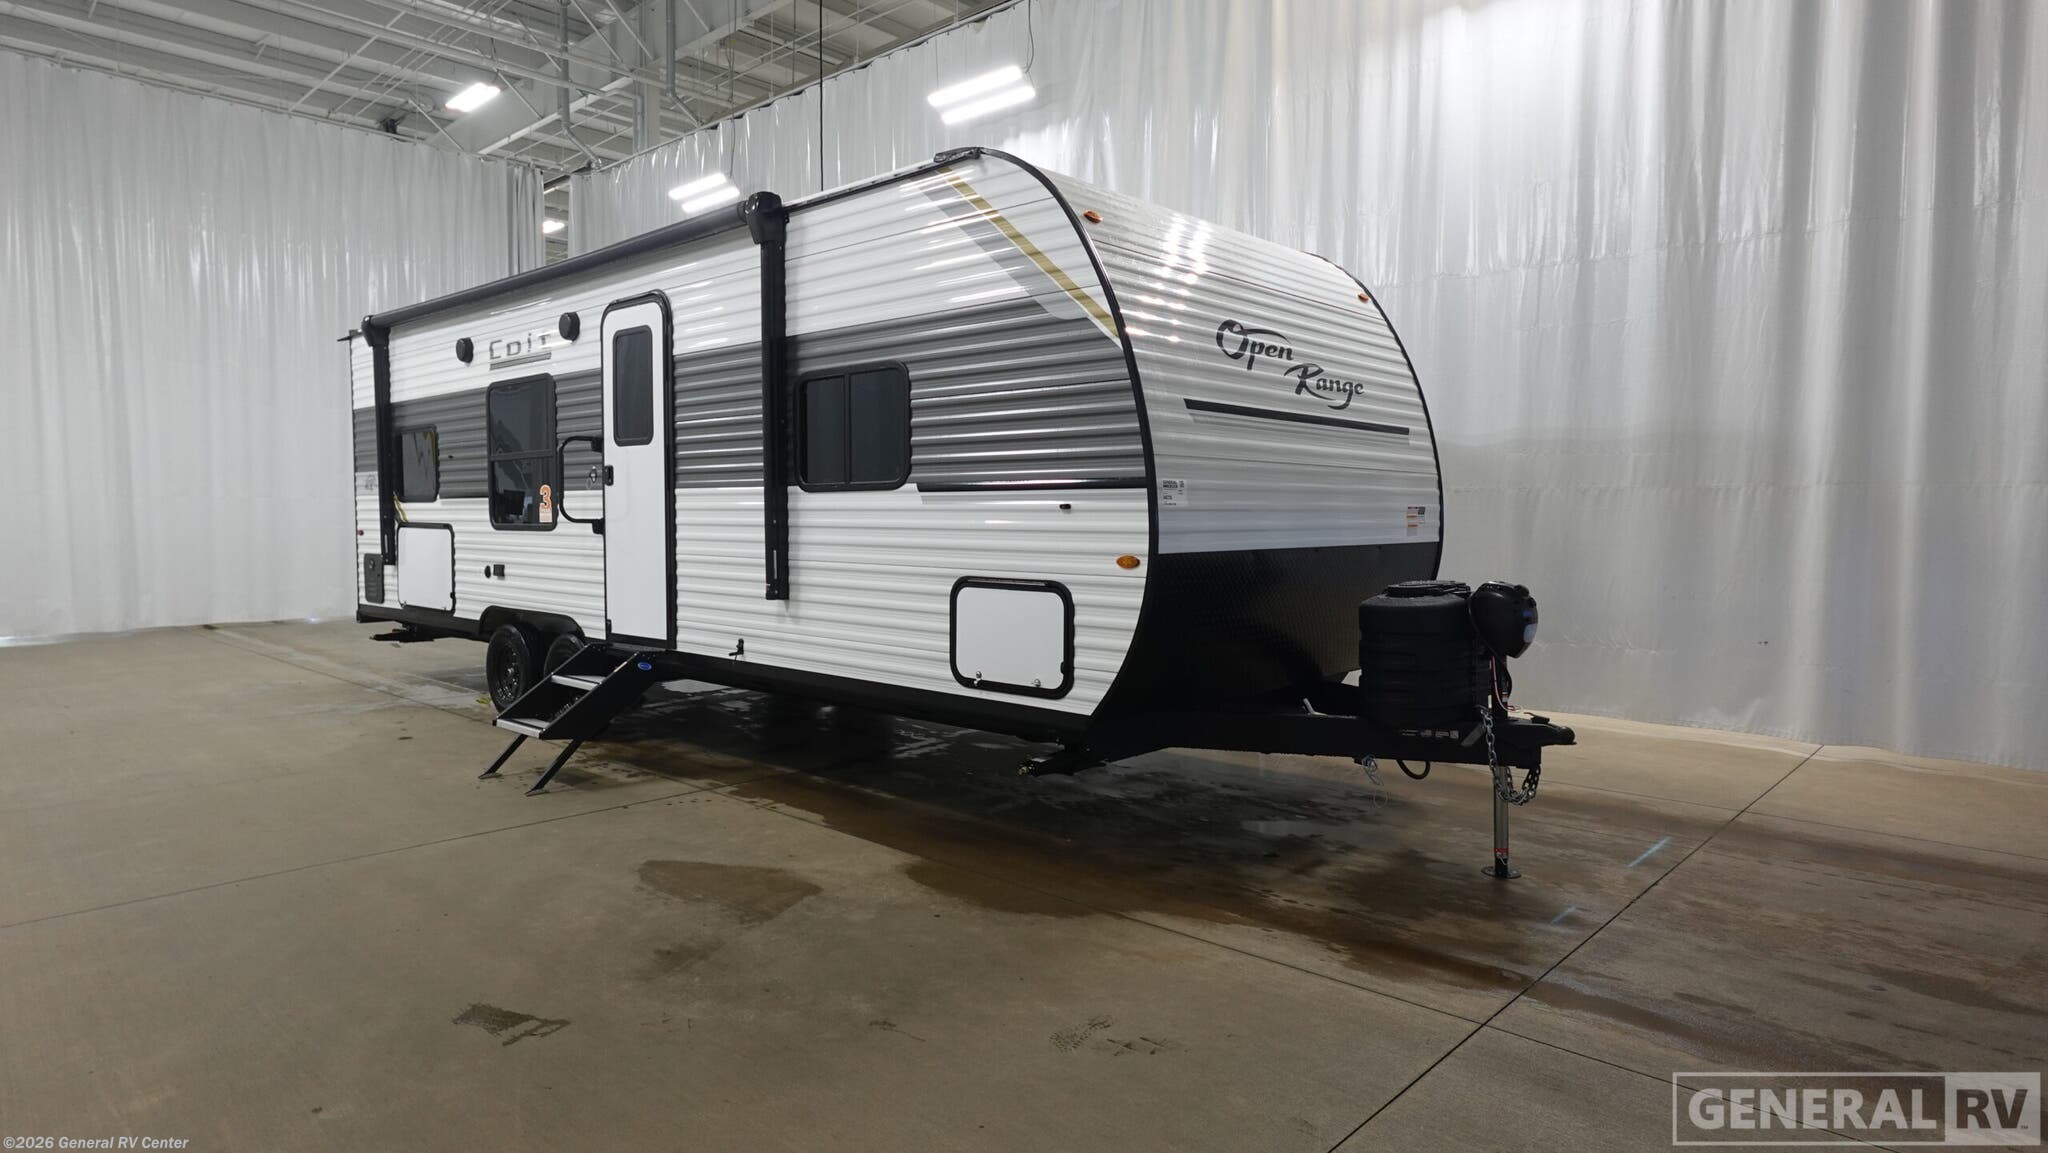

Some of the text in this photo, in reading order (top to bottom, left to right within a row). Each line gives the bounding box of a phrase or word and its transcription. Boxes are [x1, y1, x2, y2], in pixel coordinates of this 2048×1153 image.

[1216, 319, 1294, 370] Open
[1283, 363, 1365, 410] Range
[539, 484, 552, 509] 3
